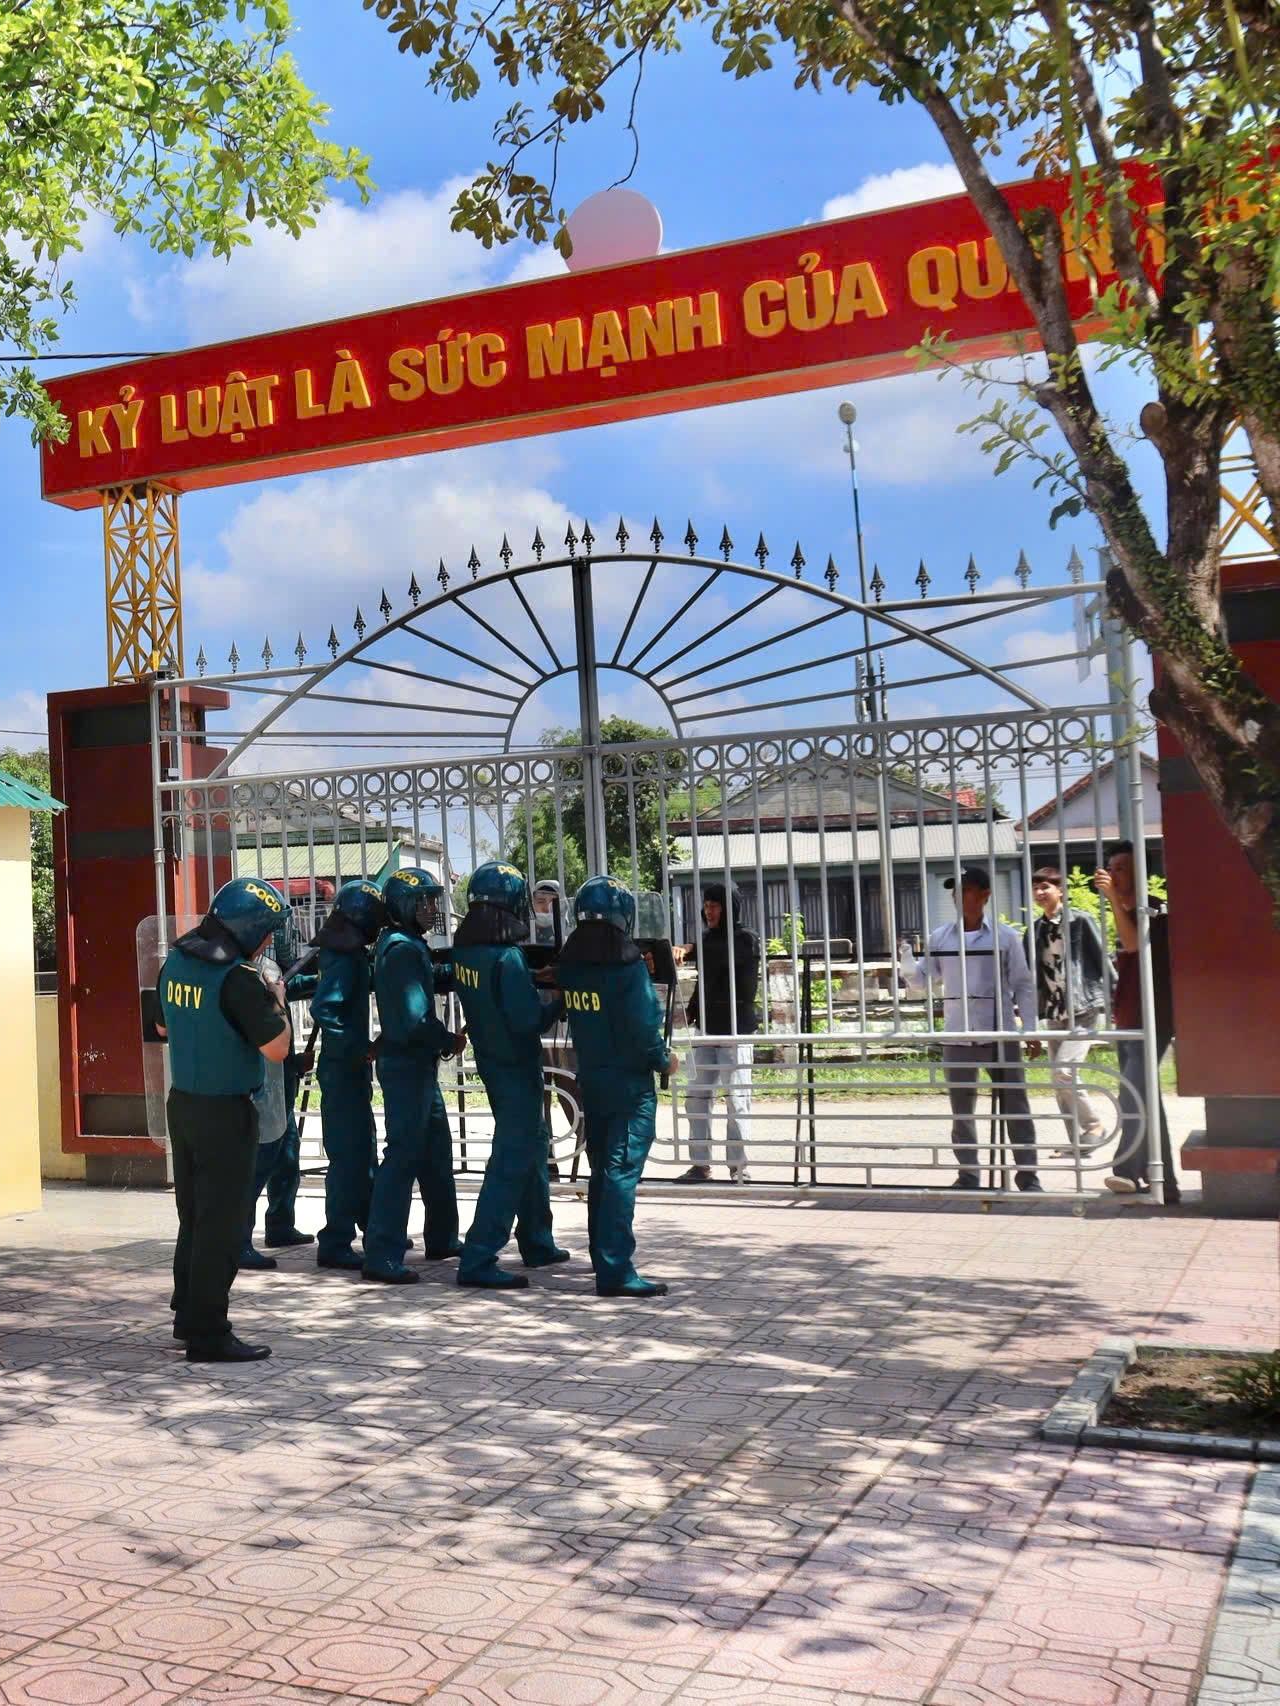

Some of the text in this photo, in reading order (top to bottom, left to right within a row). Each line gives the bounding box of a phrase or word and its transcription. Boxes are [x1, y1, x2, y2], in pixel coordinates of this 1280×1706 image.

[78, 386, 144, 459] KỶ
[160, 371, 280, 444] LUẬT
[294, 349, 372, 420] LÀ
[388, 329, 507, 403] SỨC
[526, 291, 722, 379] MẠNH
[743, 252, 888, 338] CỦA
[908, 208, 1118, 312] QUN
[167, 980, 202, 1009] DQTV
